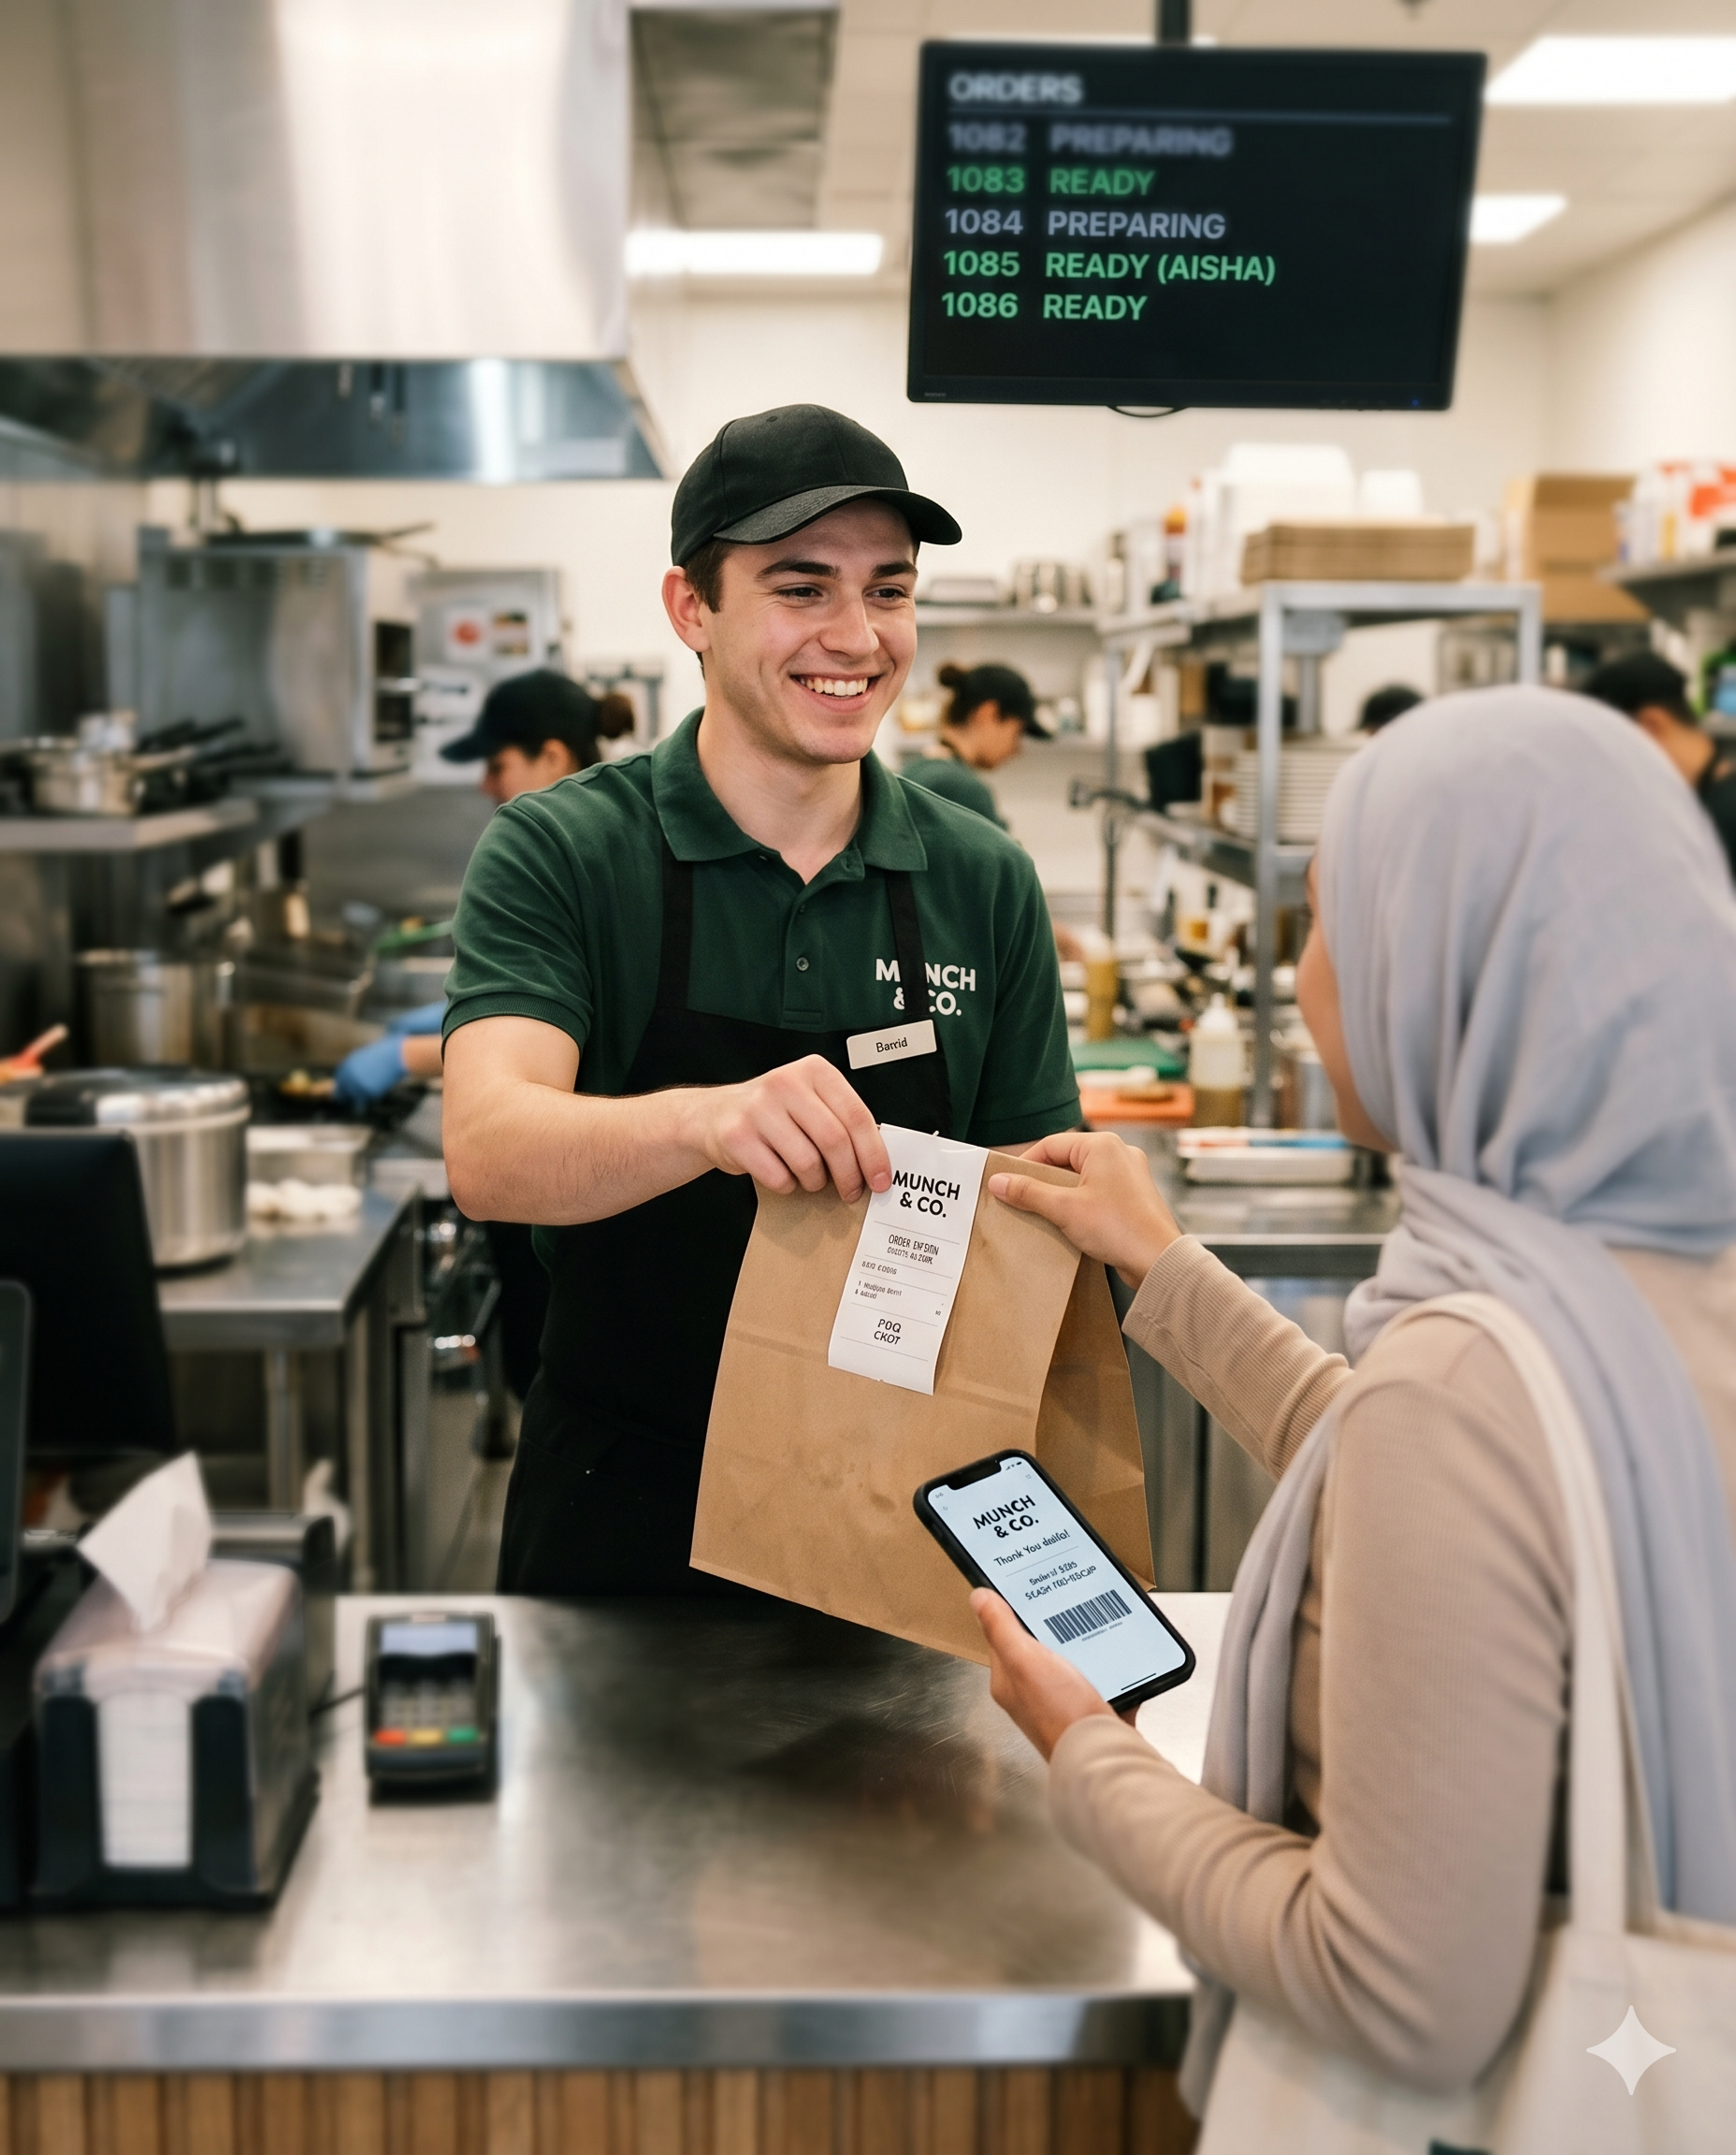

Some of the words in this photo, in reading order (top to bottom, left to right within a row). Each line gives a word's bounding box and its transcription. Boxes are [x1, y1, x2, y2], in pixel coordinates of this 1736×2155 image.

[948, 74, 1083, 104] ORDERS
[948, 123, 1026, 152] 1082
[1049, 126, 1232, 156] PREPARING
[948, 166, 1024, 193] 1083
[1049, 168, 1155, 195] READY
[945, 209, 1023, 235] 1084
[1048, 210, 1225, 239] PREPARING
[943, 251, 1020, 276] 1085
[1046, 253, 1150, 279] READY
[1157, 254, 1275, 285] (AISHA)
[941, 292, 1018, 318] 1086
[1043, 295, 1148, 320] READY
[875, 958, 976, 991] MNCH
[892, 1170, 961, 1200] MUNCH
[900, 1192, 913, 1208] &
[917, 1196, 947, 1218] CO.
[889, 1234, 911, 1248] ORDER
[874, 1331, 901, 1345] CKOT
[973, 1495, 1035, 1529] MUNCH
[993, 1526, 1009, 1538] &
[1008, 1514, 1039, 1531] CO.
[1023, 1543, 1042, 1554] You
